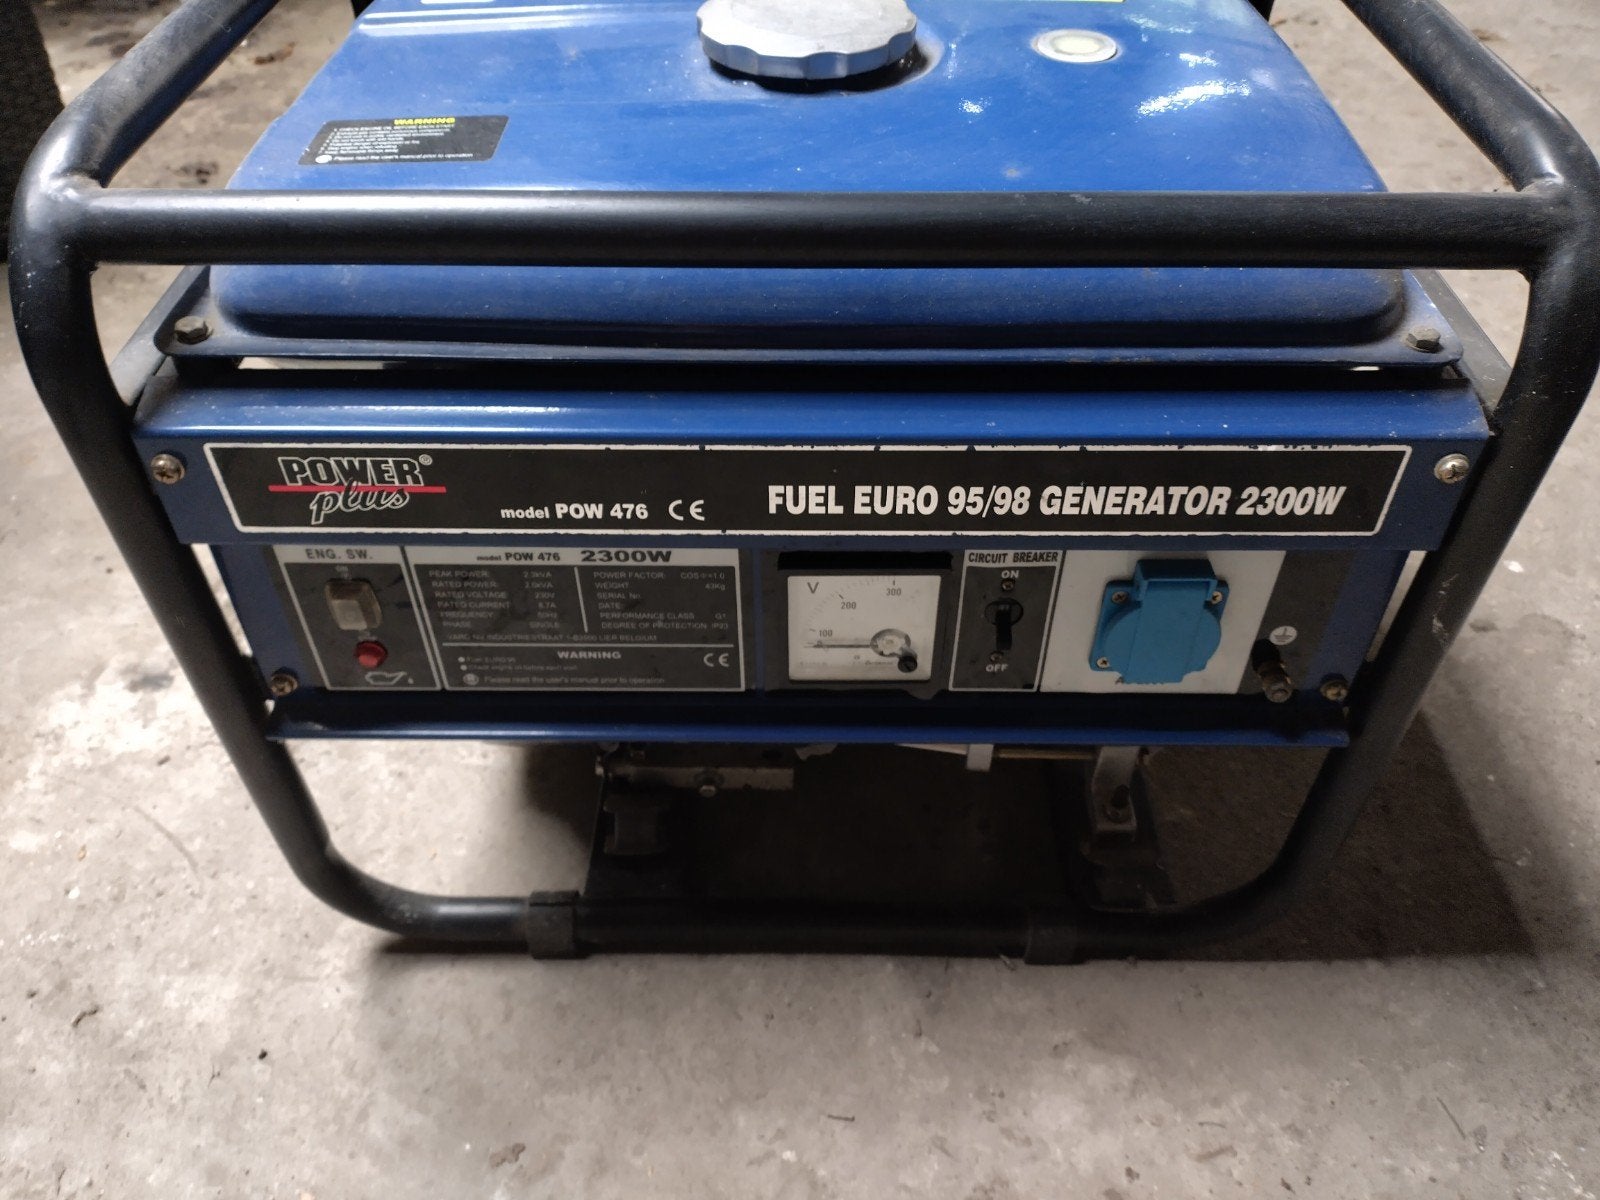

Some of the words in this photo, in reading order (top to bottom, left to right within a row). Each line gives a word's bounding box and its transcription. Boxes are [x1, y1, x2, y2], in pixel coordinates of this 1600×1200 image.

[394, 117, 456, 126] WARNING
[309, 476, 410, 525] plus
[768, 485, 844, 515] FUEL
[854, 485, 939, 515] EURO
[947, 485, 1031, 518] 95/98
[1039, 485, 1232, 516] GENERATOR
[1235, 485, 1347, 516] 2300W
[500, 506, 549, 519] model
[555, 503, 603, 519] POW
[610, 503, 648, 519] 476
[305, 549, 342, 559] ENG.
[345, 549, 373, 559] SW.
[505, 552, 534, 562] POW
[537, 552, 561, 562] 476
[581, 550, 672, 563] 2300W
[968, 552, 1008, 563] CIRCUIT
[1012, 551, 1059, 563] BREAKER
[429, 570, 452, 578] PEAK
[1001, 570, 1020, 579] ON
[807, 582, 820, 594] V
[886, 588, 902, 596] 300
[840, 601, 857, 610] 200
[819, 629, 833, 637] 100
[557, 651, 622, 659] WARNING
[985, 663, 1009, 673] OFF
